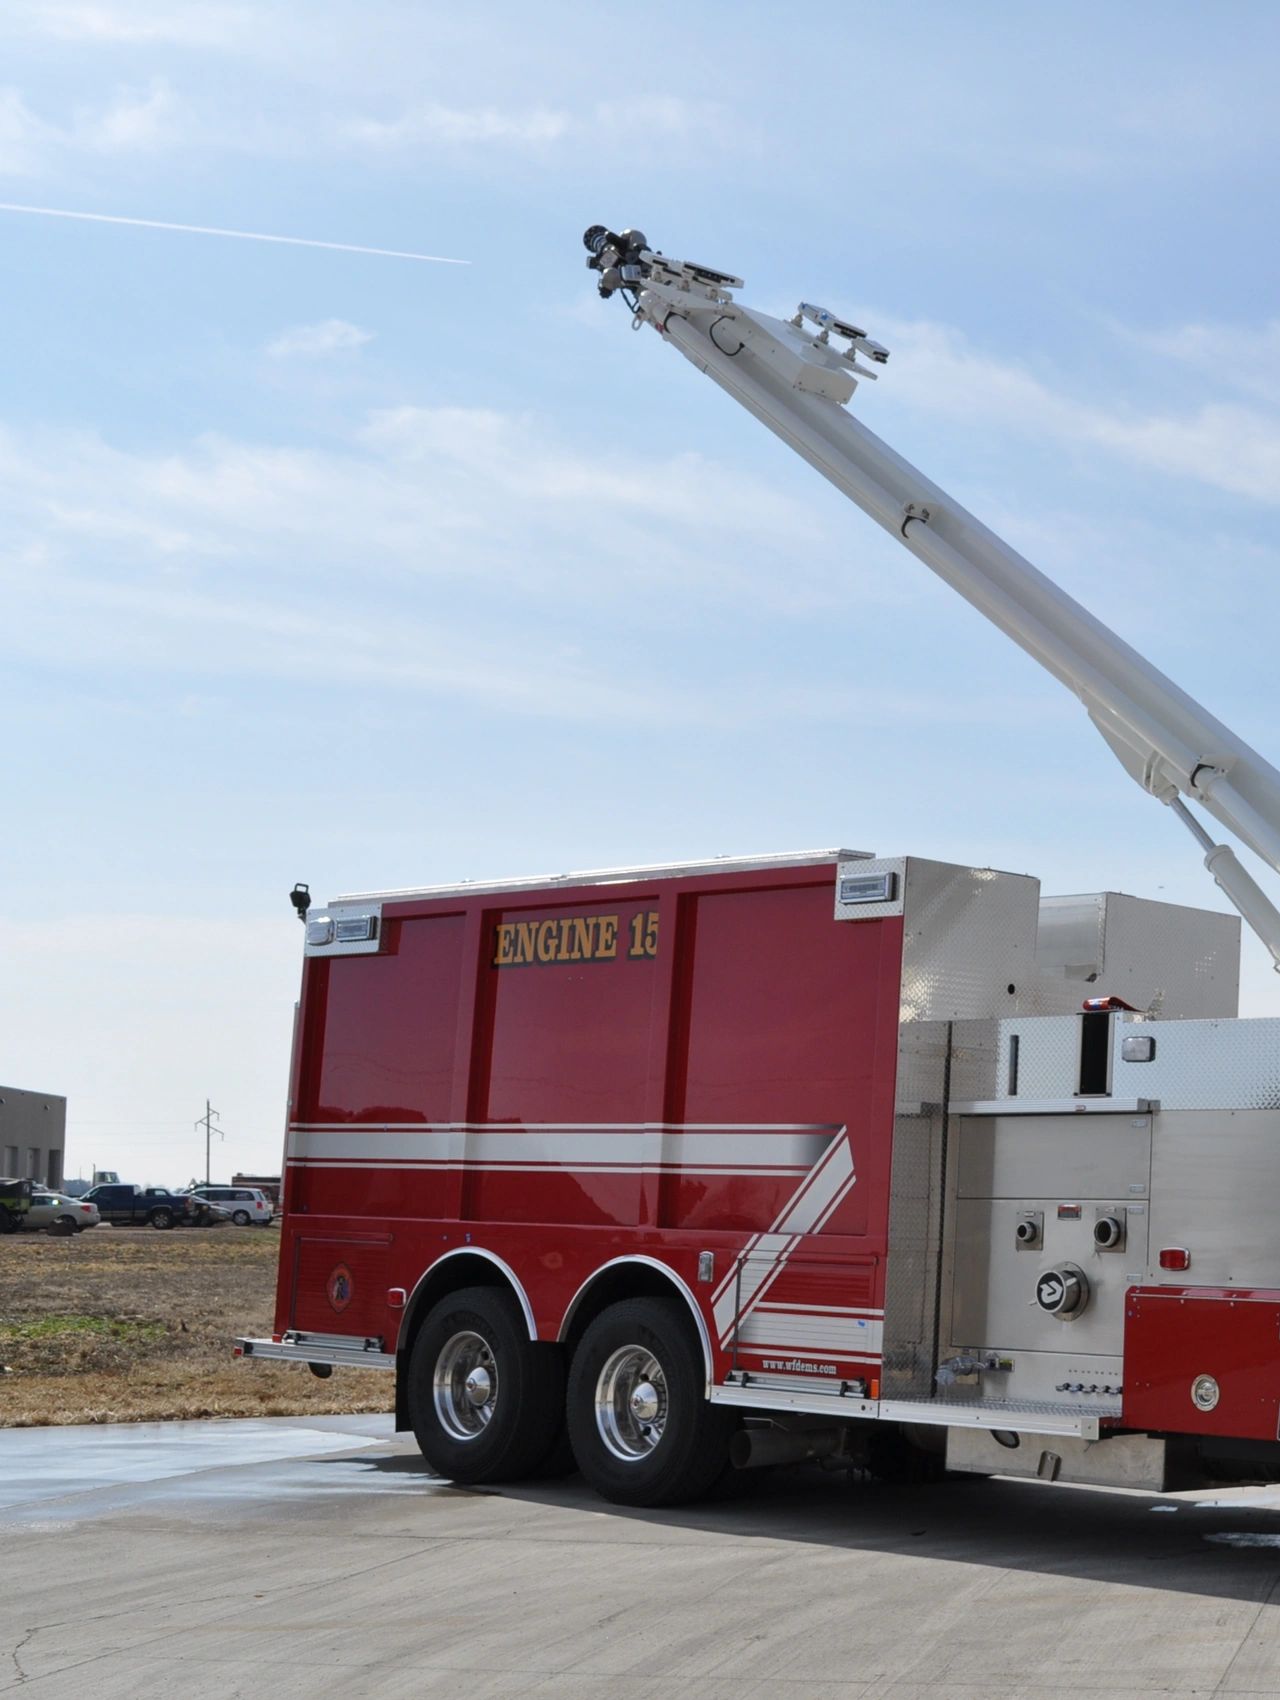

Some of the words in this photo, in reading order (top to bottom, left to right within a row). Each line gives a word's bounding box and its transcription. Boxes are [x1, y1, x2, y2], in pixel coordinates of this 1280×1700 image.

[493, 914, 619, 965] ENGINE
[628, 911, 660, 957] 15
[762, 1359, 837, 1375] www.wfdems.com
